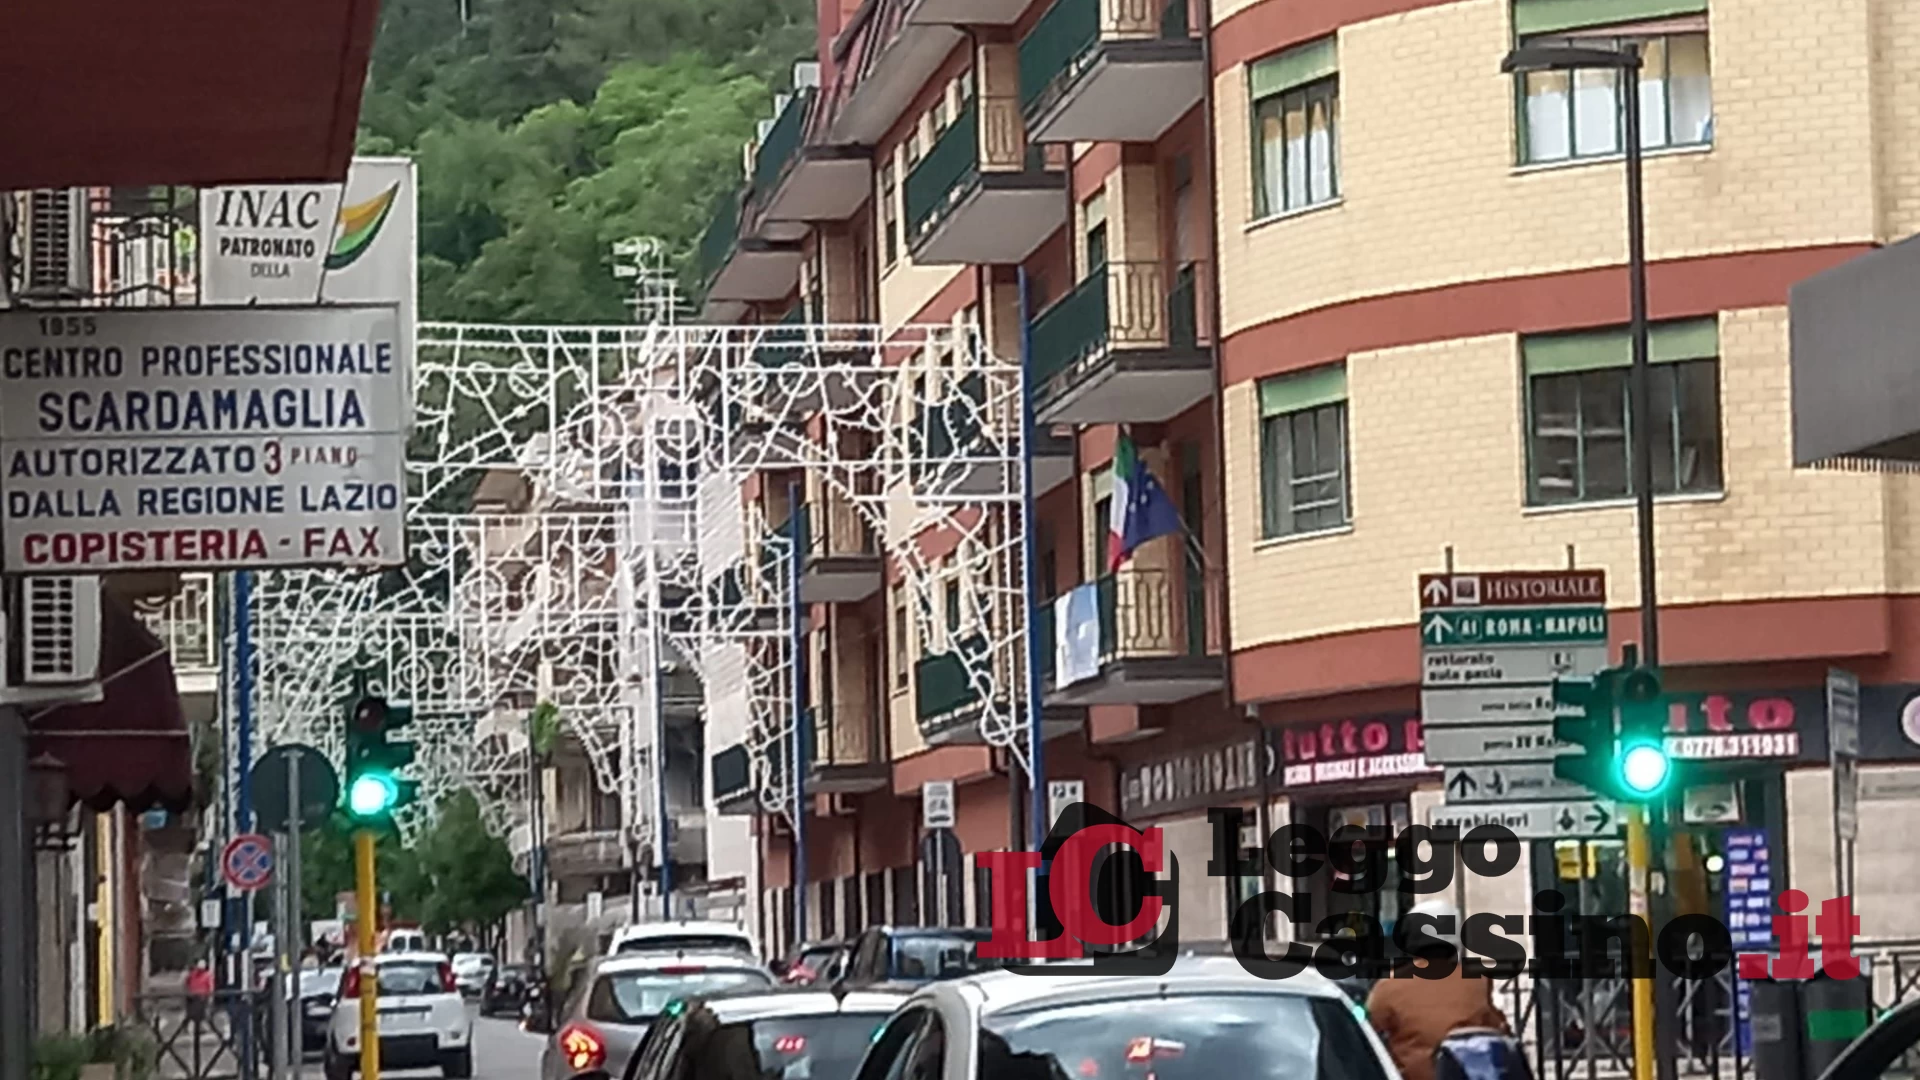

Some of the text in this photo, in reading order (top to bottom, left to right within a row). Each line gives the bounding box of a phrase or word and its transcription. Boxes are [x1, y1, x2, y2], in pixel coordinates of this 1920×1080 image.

[215, 190, 322, 229] INAC
[220, 237, 315, 258] PATRONATO
[251, 262, 290, 278] DELLA
[4, 342, 391, 379] CENTRO PROFESSIONALE
[38, 388, 366, 433] SCARDAMAGLIA
[8, 441, 357, 478] AUTORIZZATO 3 PIANO
[8, 484, 397, 519] DALLA REGIONE LAZIO
[23, 529, 268, 564] COPISTERIA
[304, 527, 381, 558] FAX
